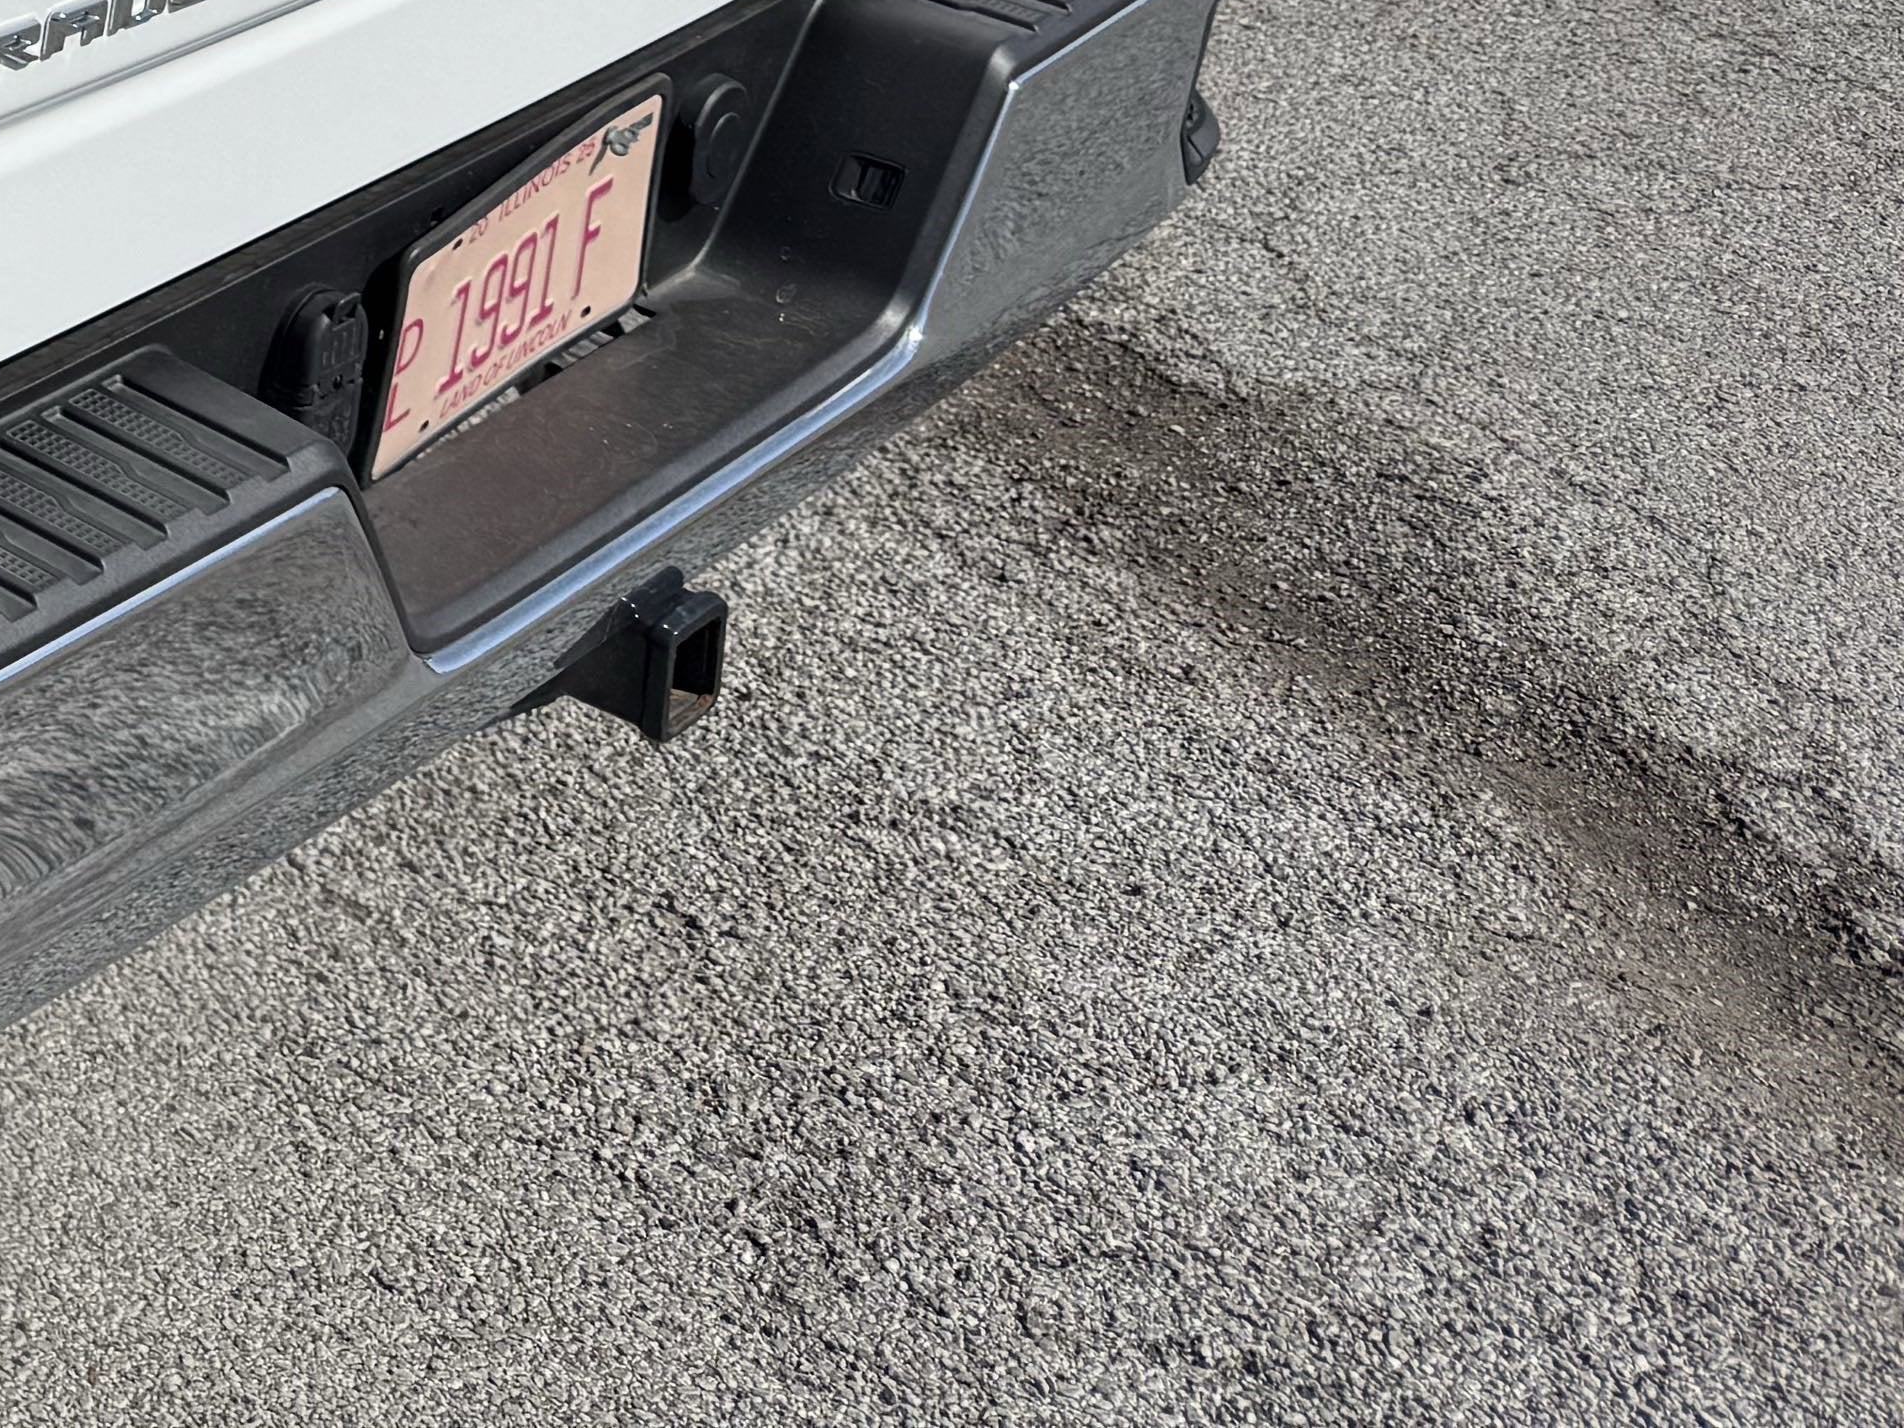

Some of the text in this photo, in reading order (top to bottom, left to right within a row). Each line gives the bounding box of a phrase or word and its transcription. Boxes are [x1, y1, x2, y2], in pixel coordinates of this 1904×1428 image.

[498, 153, 571, 222] ILLINOIS
[436, 176, 614, 395] 1991 F
[382, 382, 411, 432] L
[440, 309, 573, 419] LAND OF LINCOLN
